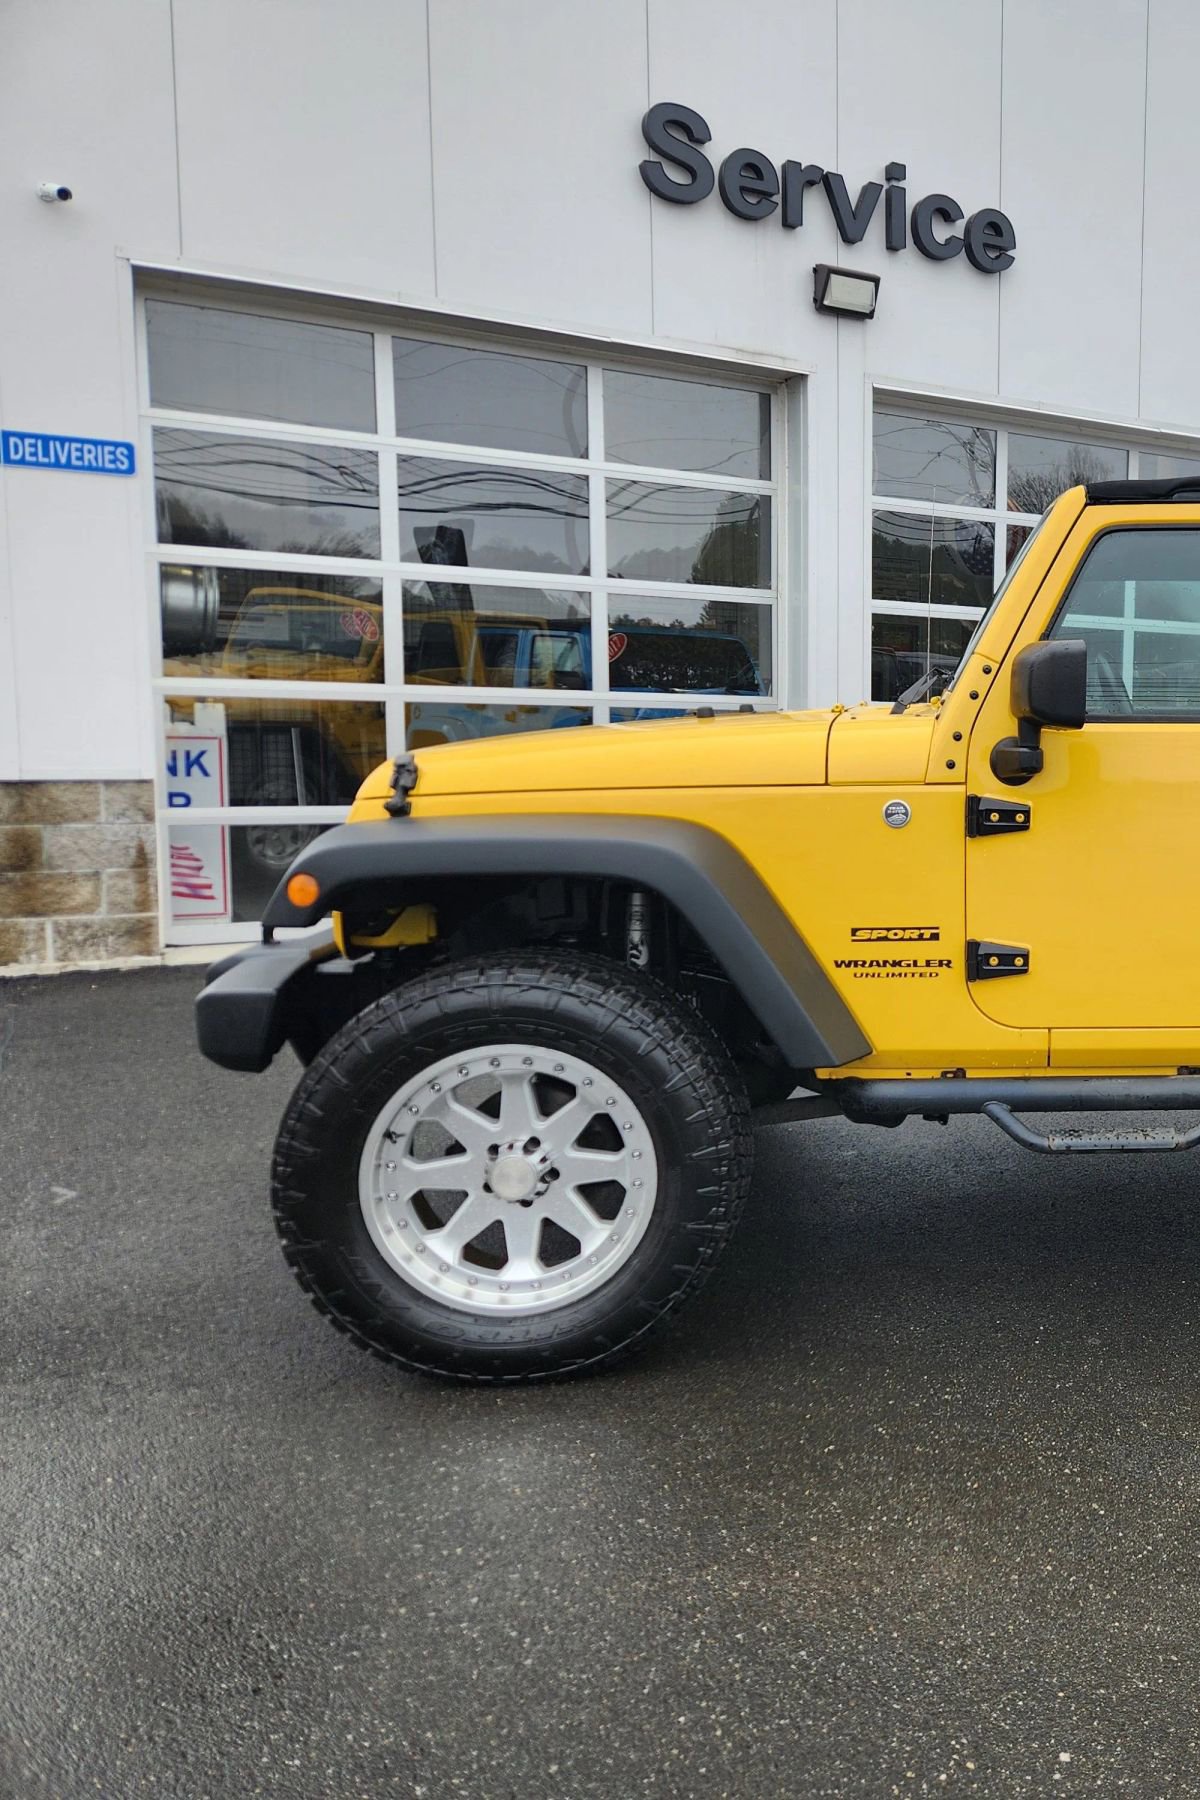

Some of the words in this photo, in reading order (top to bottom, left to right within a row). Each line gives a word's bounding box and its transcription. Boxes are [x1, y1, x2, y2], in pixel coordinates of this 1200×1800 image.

[639, 102, 1017, 274] Service
[9, 436, 129, 470] DELIVERIES
[851, 927, 940, 941] SPORT
[833, 959, 952, 969] WRANGLER
[853, 971, 939, 979] UNLIMITED
